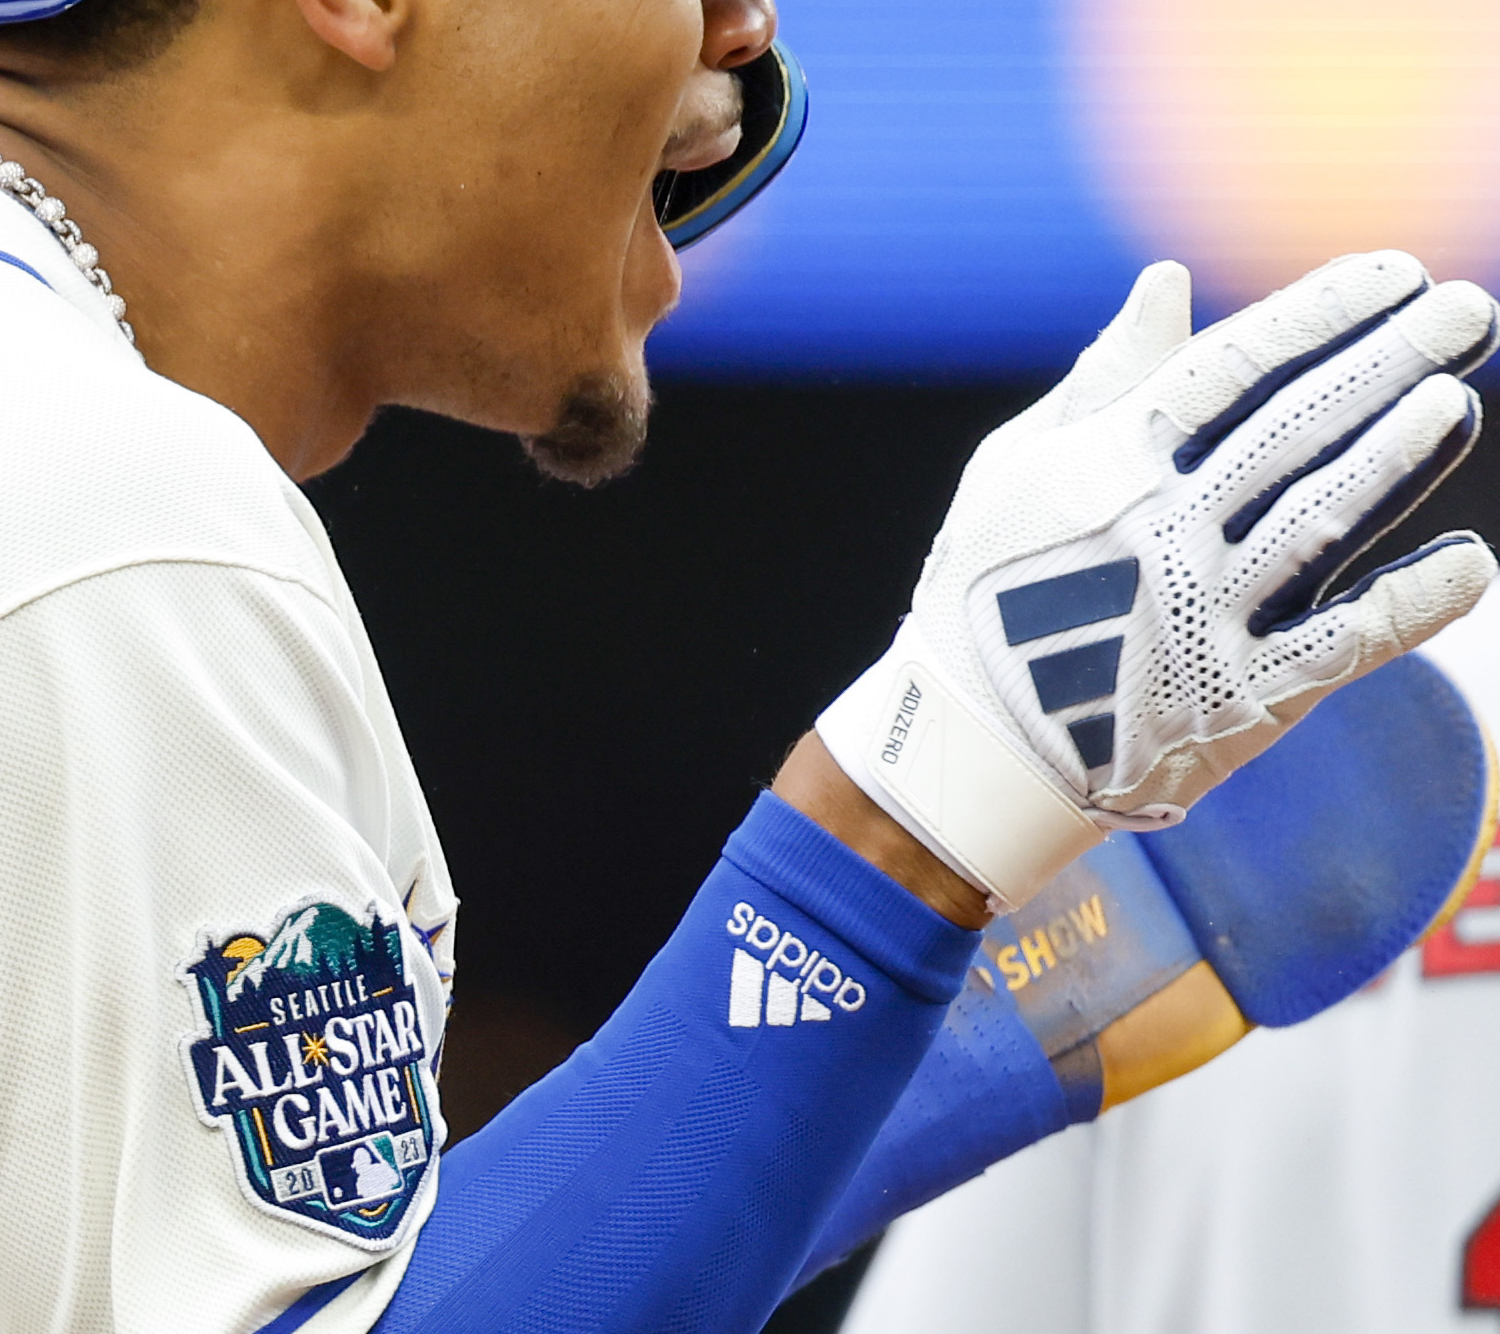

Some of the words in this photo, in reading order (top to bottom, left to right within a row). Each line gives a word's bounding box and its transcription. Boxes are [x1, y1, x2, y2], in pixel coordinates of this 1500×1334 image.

[881, 678, 922, 765] ADIZERO
[726, 901, 866, 1012] adidas
[997, 894, 1108, 991] SHOW
[270, 974, 370, 1026] SEATTLE
[273, 1067, 407, 1151] GAME
